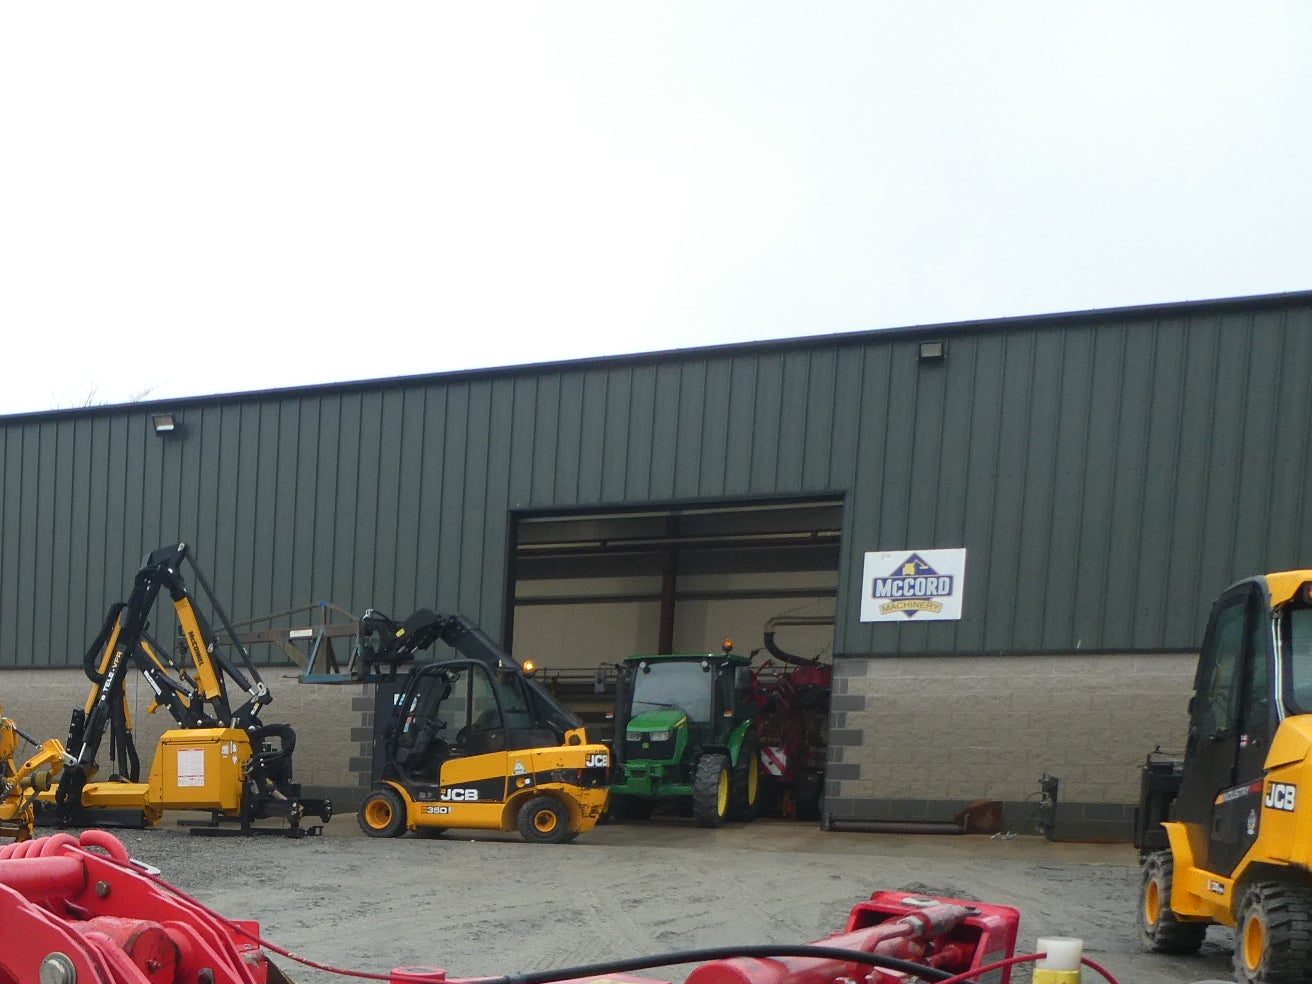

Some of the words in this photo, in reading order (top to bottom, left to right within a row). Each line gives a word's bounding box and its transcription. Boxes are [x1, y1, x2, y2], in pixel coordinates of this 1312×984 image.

[881, 601, 940, 612] MACHINERY
[585, 754, 608, 767] JCB
[440, 788, 478, 801] JCB
[1265, 783, 1296, 811] JCB
